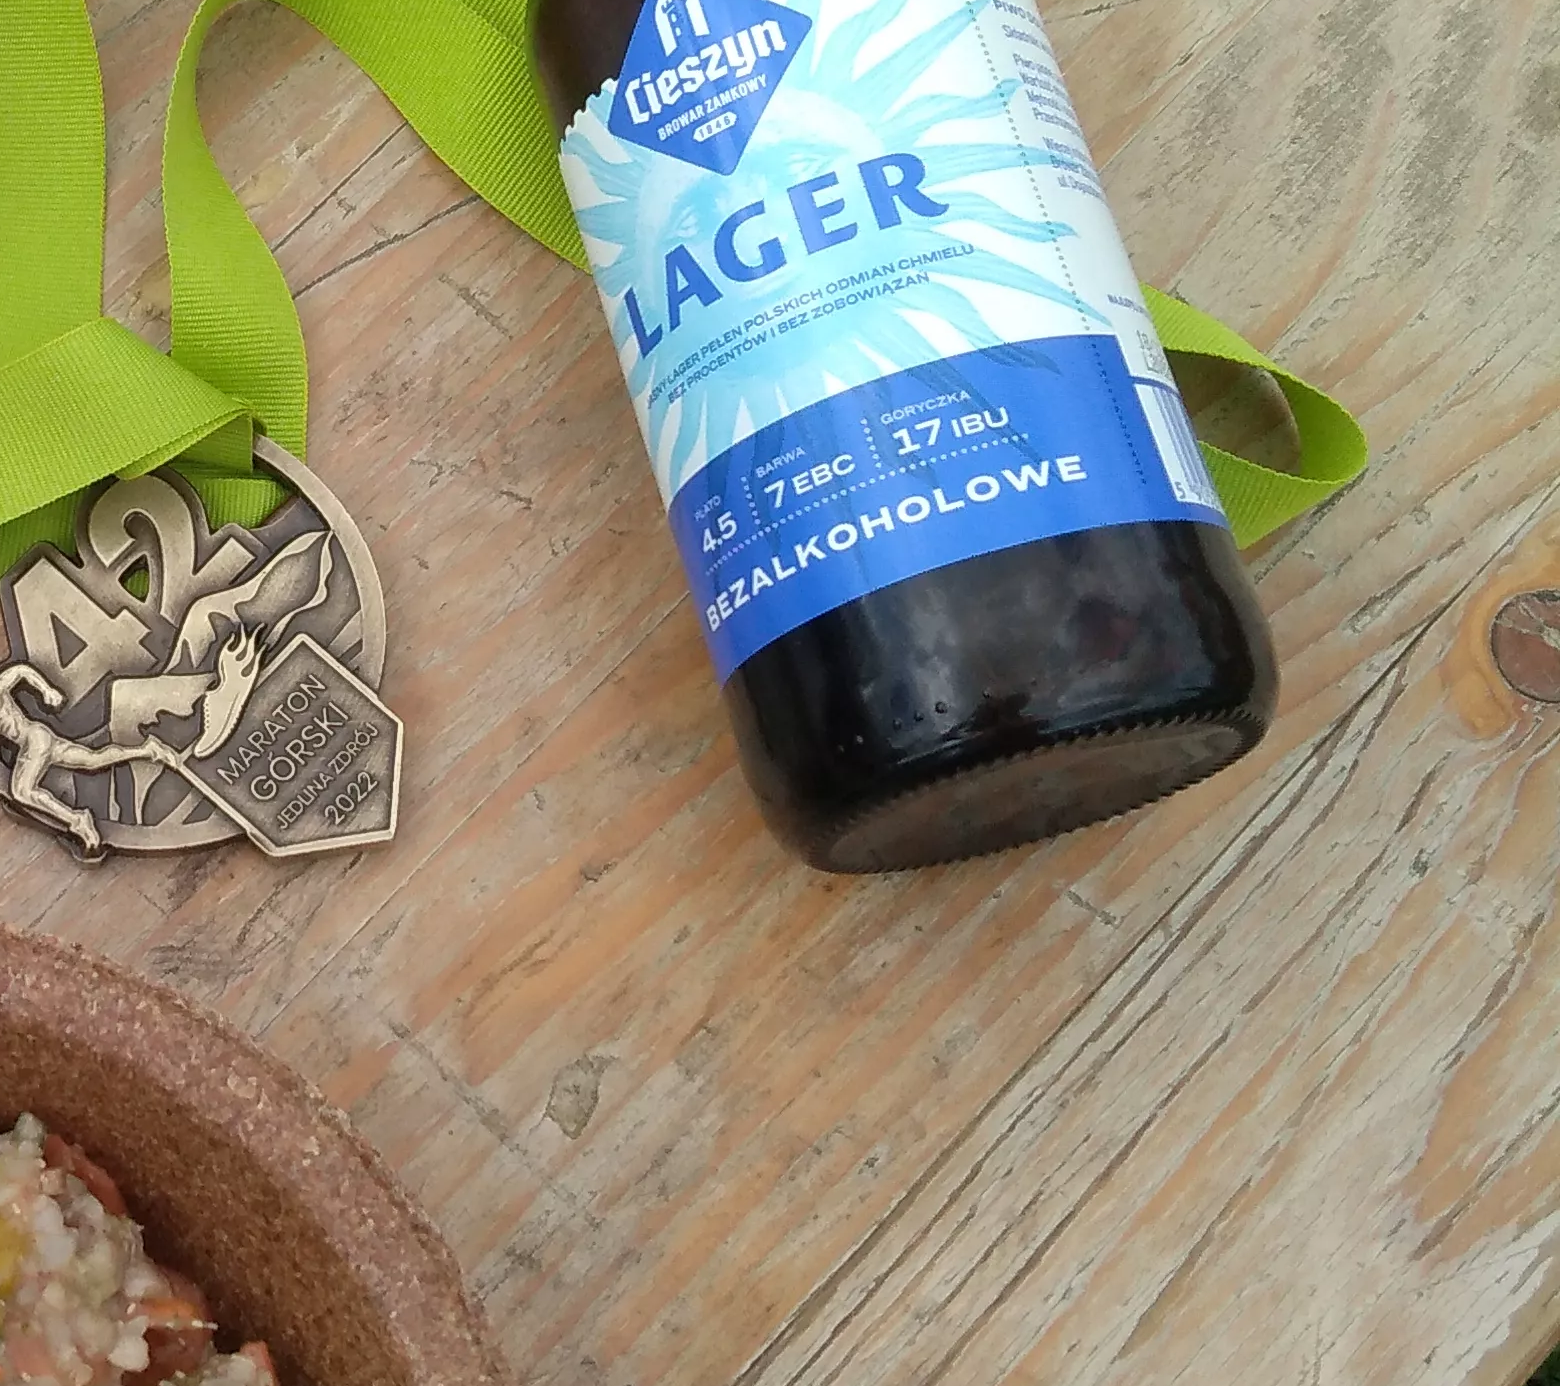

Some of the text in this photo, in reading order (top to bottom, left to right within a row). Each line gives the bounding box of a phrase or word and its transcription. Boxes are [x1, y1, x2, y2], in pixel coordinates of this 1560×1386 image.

[625, 20, 787, 125] Cieszyn
[657, 73, 767, 141] BROWAR ZAMKOWY
[698, 114, 731, 139] 1846
[623, 152, 950, 359] LAGER
[667, 351, 701, 384] LAGER
[699, 325, 743, 359] PEŁEN
[743, 288, 823, 332] POLSKICH
[825, 262, 896, 295] ODMIAN
[898, 243, 975, 270] CHMIELU
[668, 380, 687, 404] BEZ
[687, 329, 768, 389] PROCENTÓW
[777, 311, 810, 335] BEZ
[811, 269, 930, 319] ZOBOWIĄZAŃ
[880, 390, 971, 425] GORYCZKA
[892, 407, 1009, 455] 17 IBU
[755, 446, 806, 478] BARWA
[763, 453, 856, 508] 7 EBC
[705, 455, 1087, 632] BEZALKOHOLOWE
[217, 674, 328, 785] MARATON
[251, 701, 349, 801] GÓRSKI
[276, 721, 379, 830] JEDLINA ZDRÓJ
[325, 771, 379, 825] 2022
